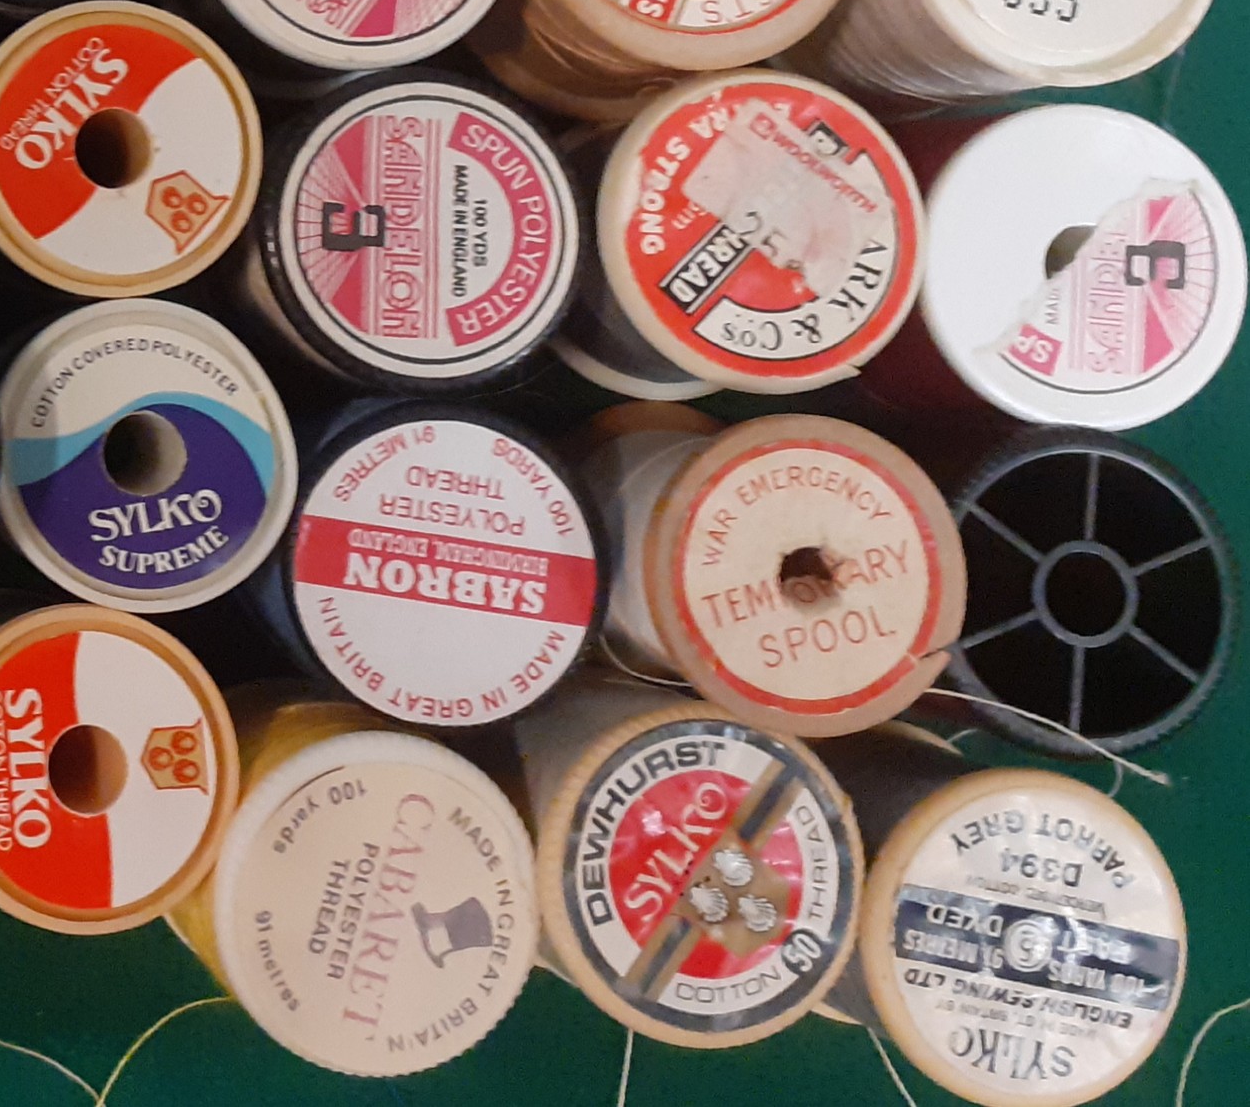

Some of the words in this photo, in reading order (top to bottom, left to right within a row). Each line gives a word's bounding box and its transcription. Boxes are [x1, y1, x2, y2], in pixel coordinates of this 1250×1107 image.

[44, 37, 104, 98] COTTON
[14, 48, 128, 168] SYLKO
[461, 123, 533, 190] SPUN
[472, 199, 488, 227] 100
[640, 136, 689, 255] STRONG
[453, 227, 468, 297] ENGLAND
[455, 195, 547, 334] POLYESTER
[472, 230, 488, 267] YDS
[32, 367, 74, 427] COTTON
[72, 338, 148, 370] COVERED
[152, 340, 238, 394] POLYESTER
[405, 465, 504, 499] THREAD
[88, 489, 222, 541] SYLKO
[377, 494, 525, 535] POLYESTER
[701, 508, 738, 565] WAR
[737, 466, 891, 519] EMERGENCY
[99, 525, 229, 573] SUPREME
[343, 552, 546, 613] SABRON
[760, 606, 896, 667] SPOOL
[3, 687, 51, 848] SYLKO
[327, 778, 366, 804] 100
[272, 796, 318, 853] yards
[586, 740, 725, 926] DEWHURST
[623, 781, 727, 922] SYLKO
[949, 810, 1023, 856] GREY
[796, 805, 827, 918] THREAD
[1000, 847, 1082, 887] D394
[308, 860, 350, 954] THREAD
[326, 842, 379, 979] POLYESTER
[342, 793, 434, 1026] CABARET
[925, 904, 1003, 936] DYED
[782, 933, 822, 972] 50
[675, 965, 780, 1003] COTTON
[949, 1026, 1074, 1079] SYLKO
